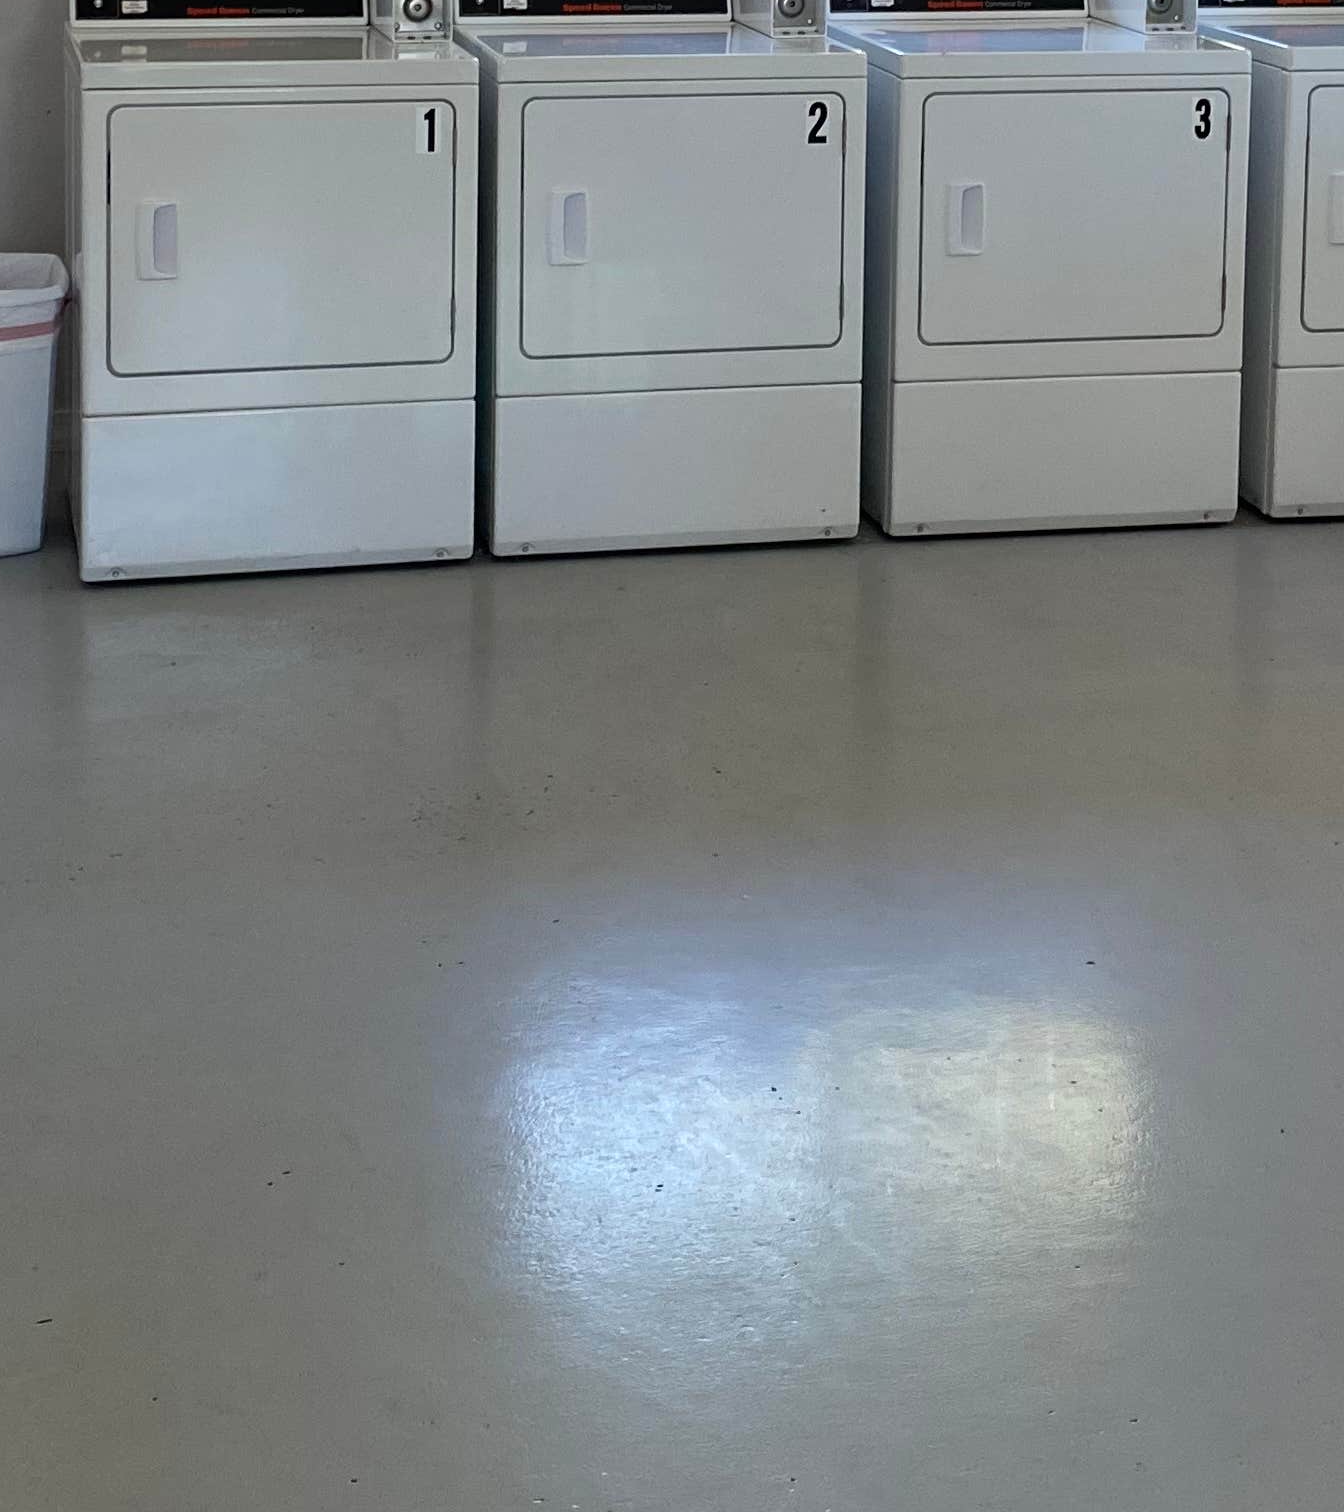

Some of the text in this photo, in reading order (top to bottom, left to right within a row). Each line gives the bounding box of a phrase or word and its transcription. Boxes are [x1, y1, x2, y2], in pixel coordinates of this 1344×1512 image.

[423, 108, 436, 153] 1
[807, 101, 828, 144] 2
[1194, 98, 1212, 139] 3
